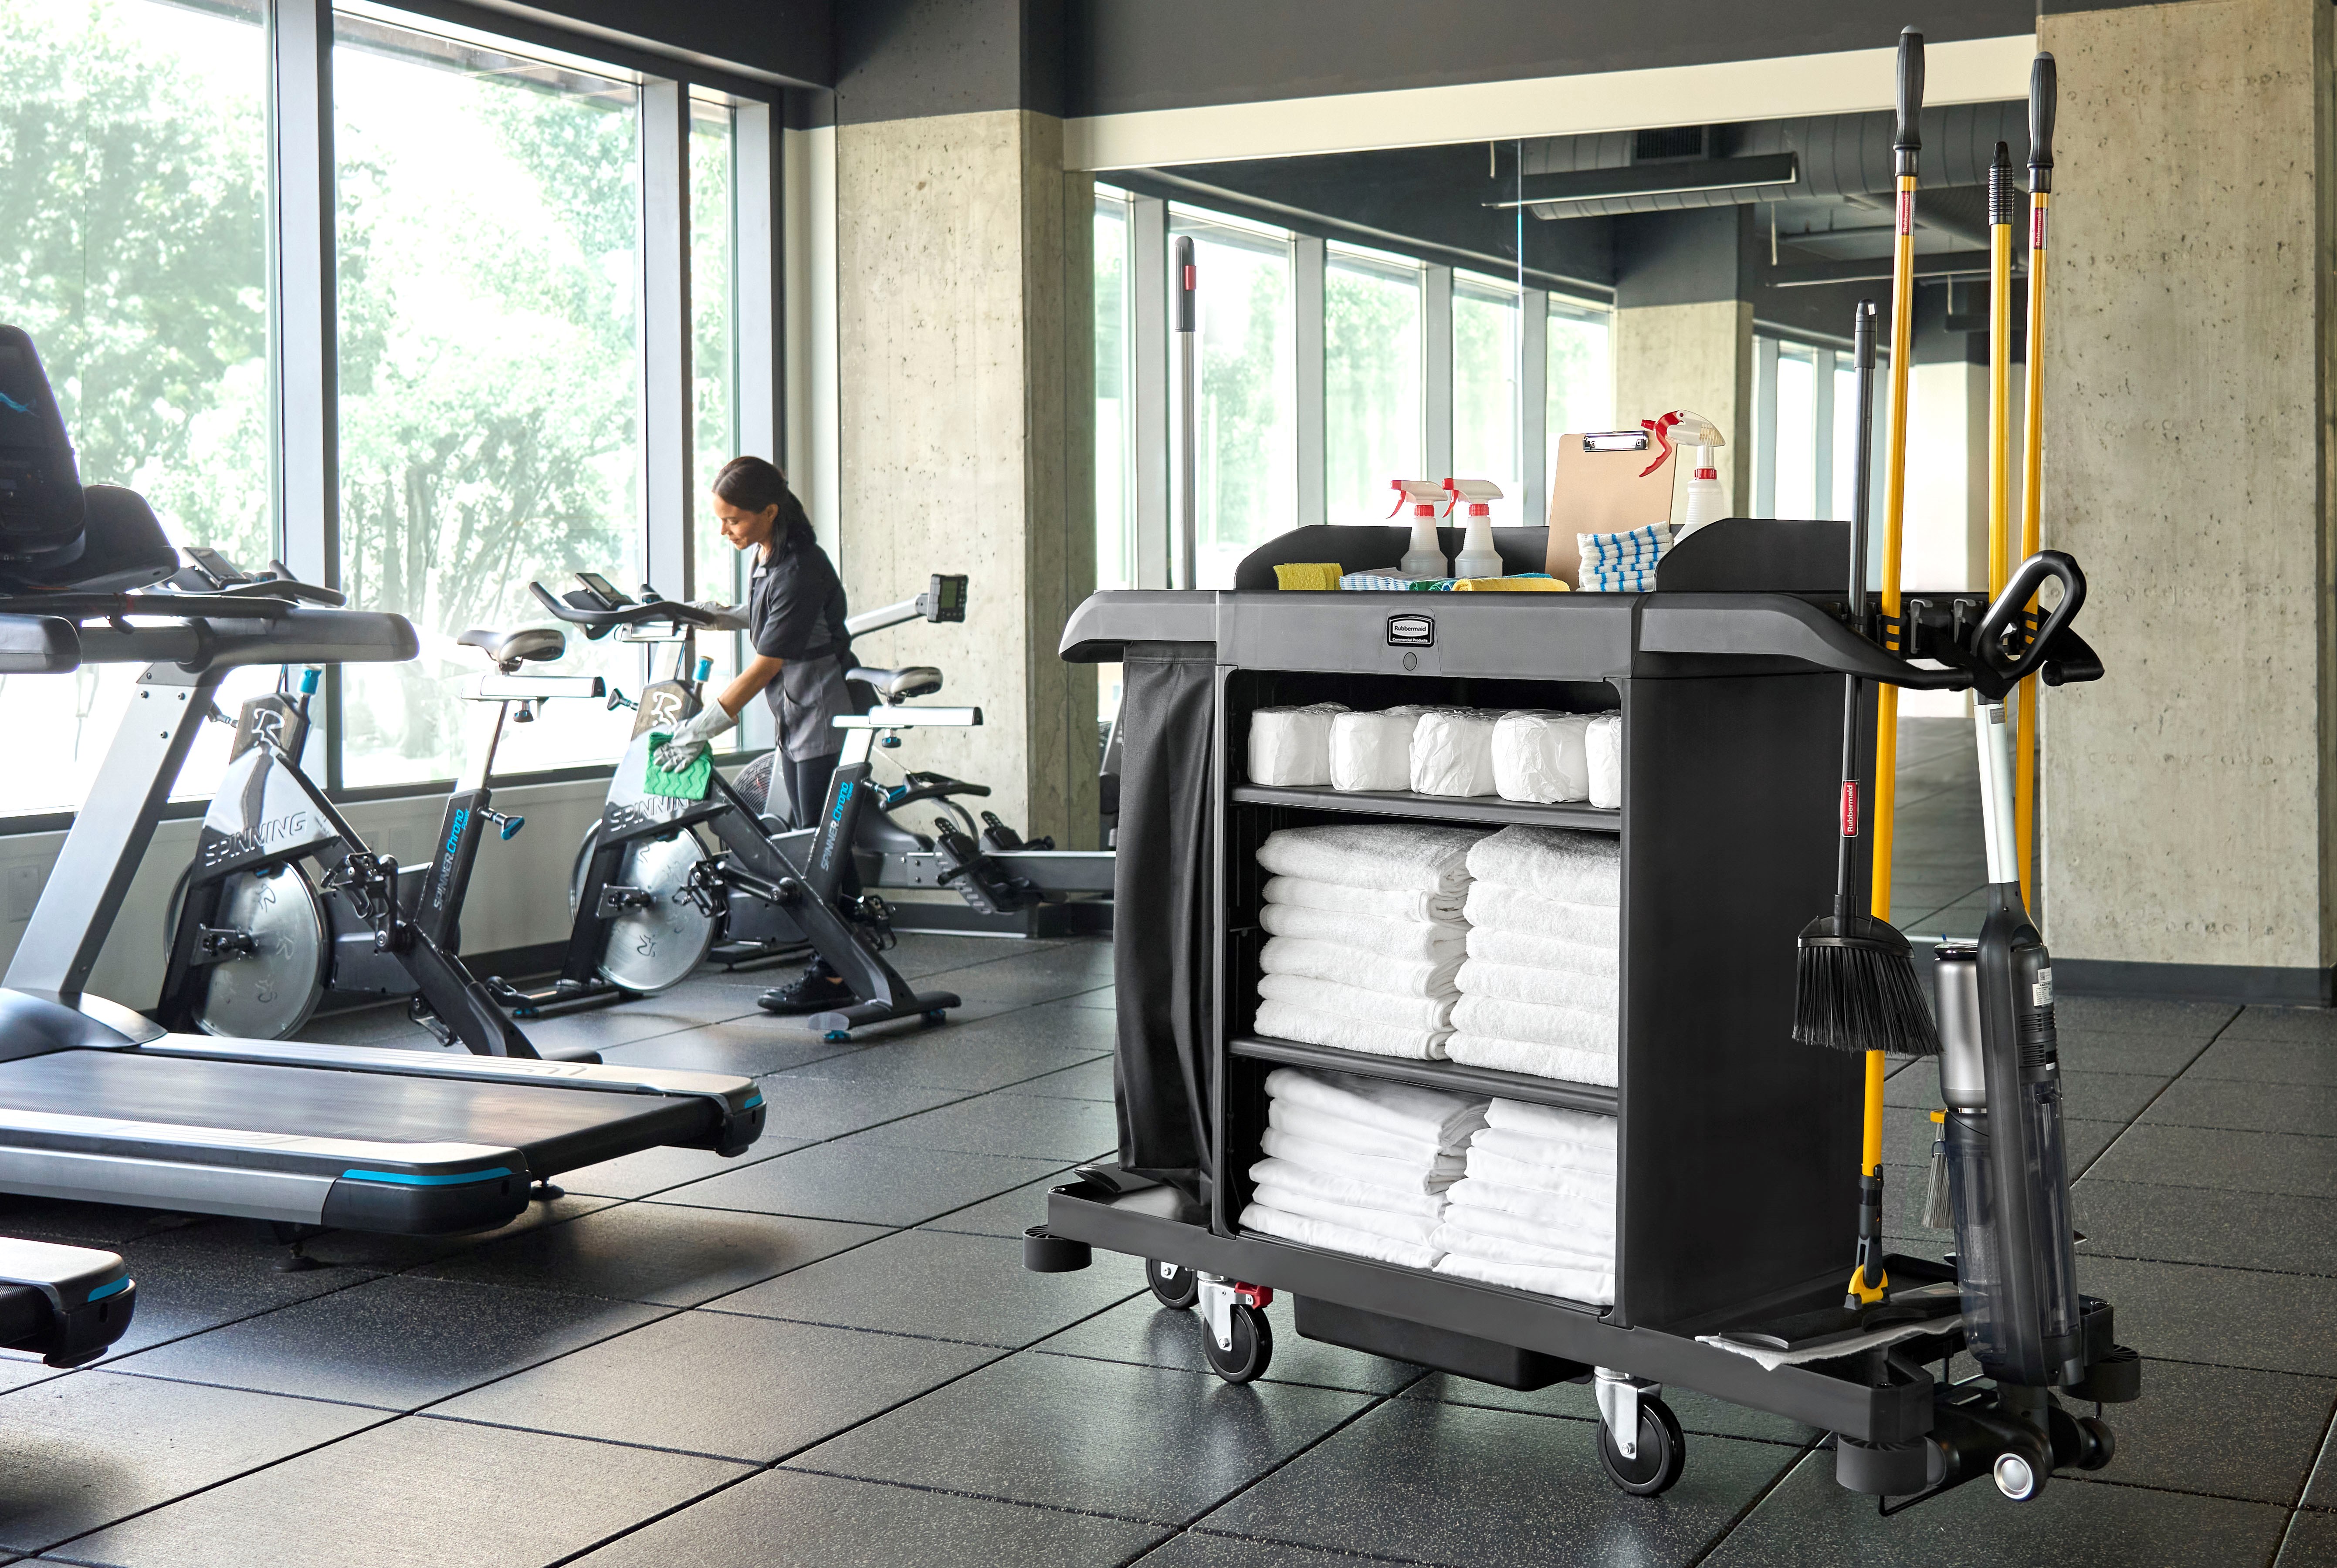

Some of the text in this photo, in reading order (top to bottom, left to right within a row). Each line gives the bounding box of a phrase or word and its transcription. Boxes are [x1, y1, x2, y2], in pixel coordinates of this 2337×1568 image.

[461, 808, 470, 830] Power
[610, 795, 703, 832] SPINNIN
[833, 781, 849, 821] Chrono
[205, 811, 307, 867] SPINNING
[447, 809, 464, 854] Chrono
